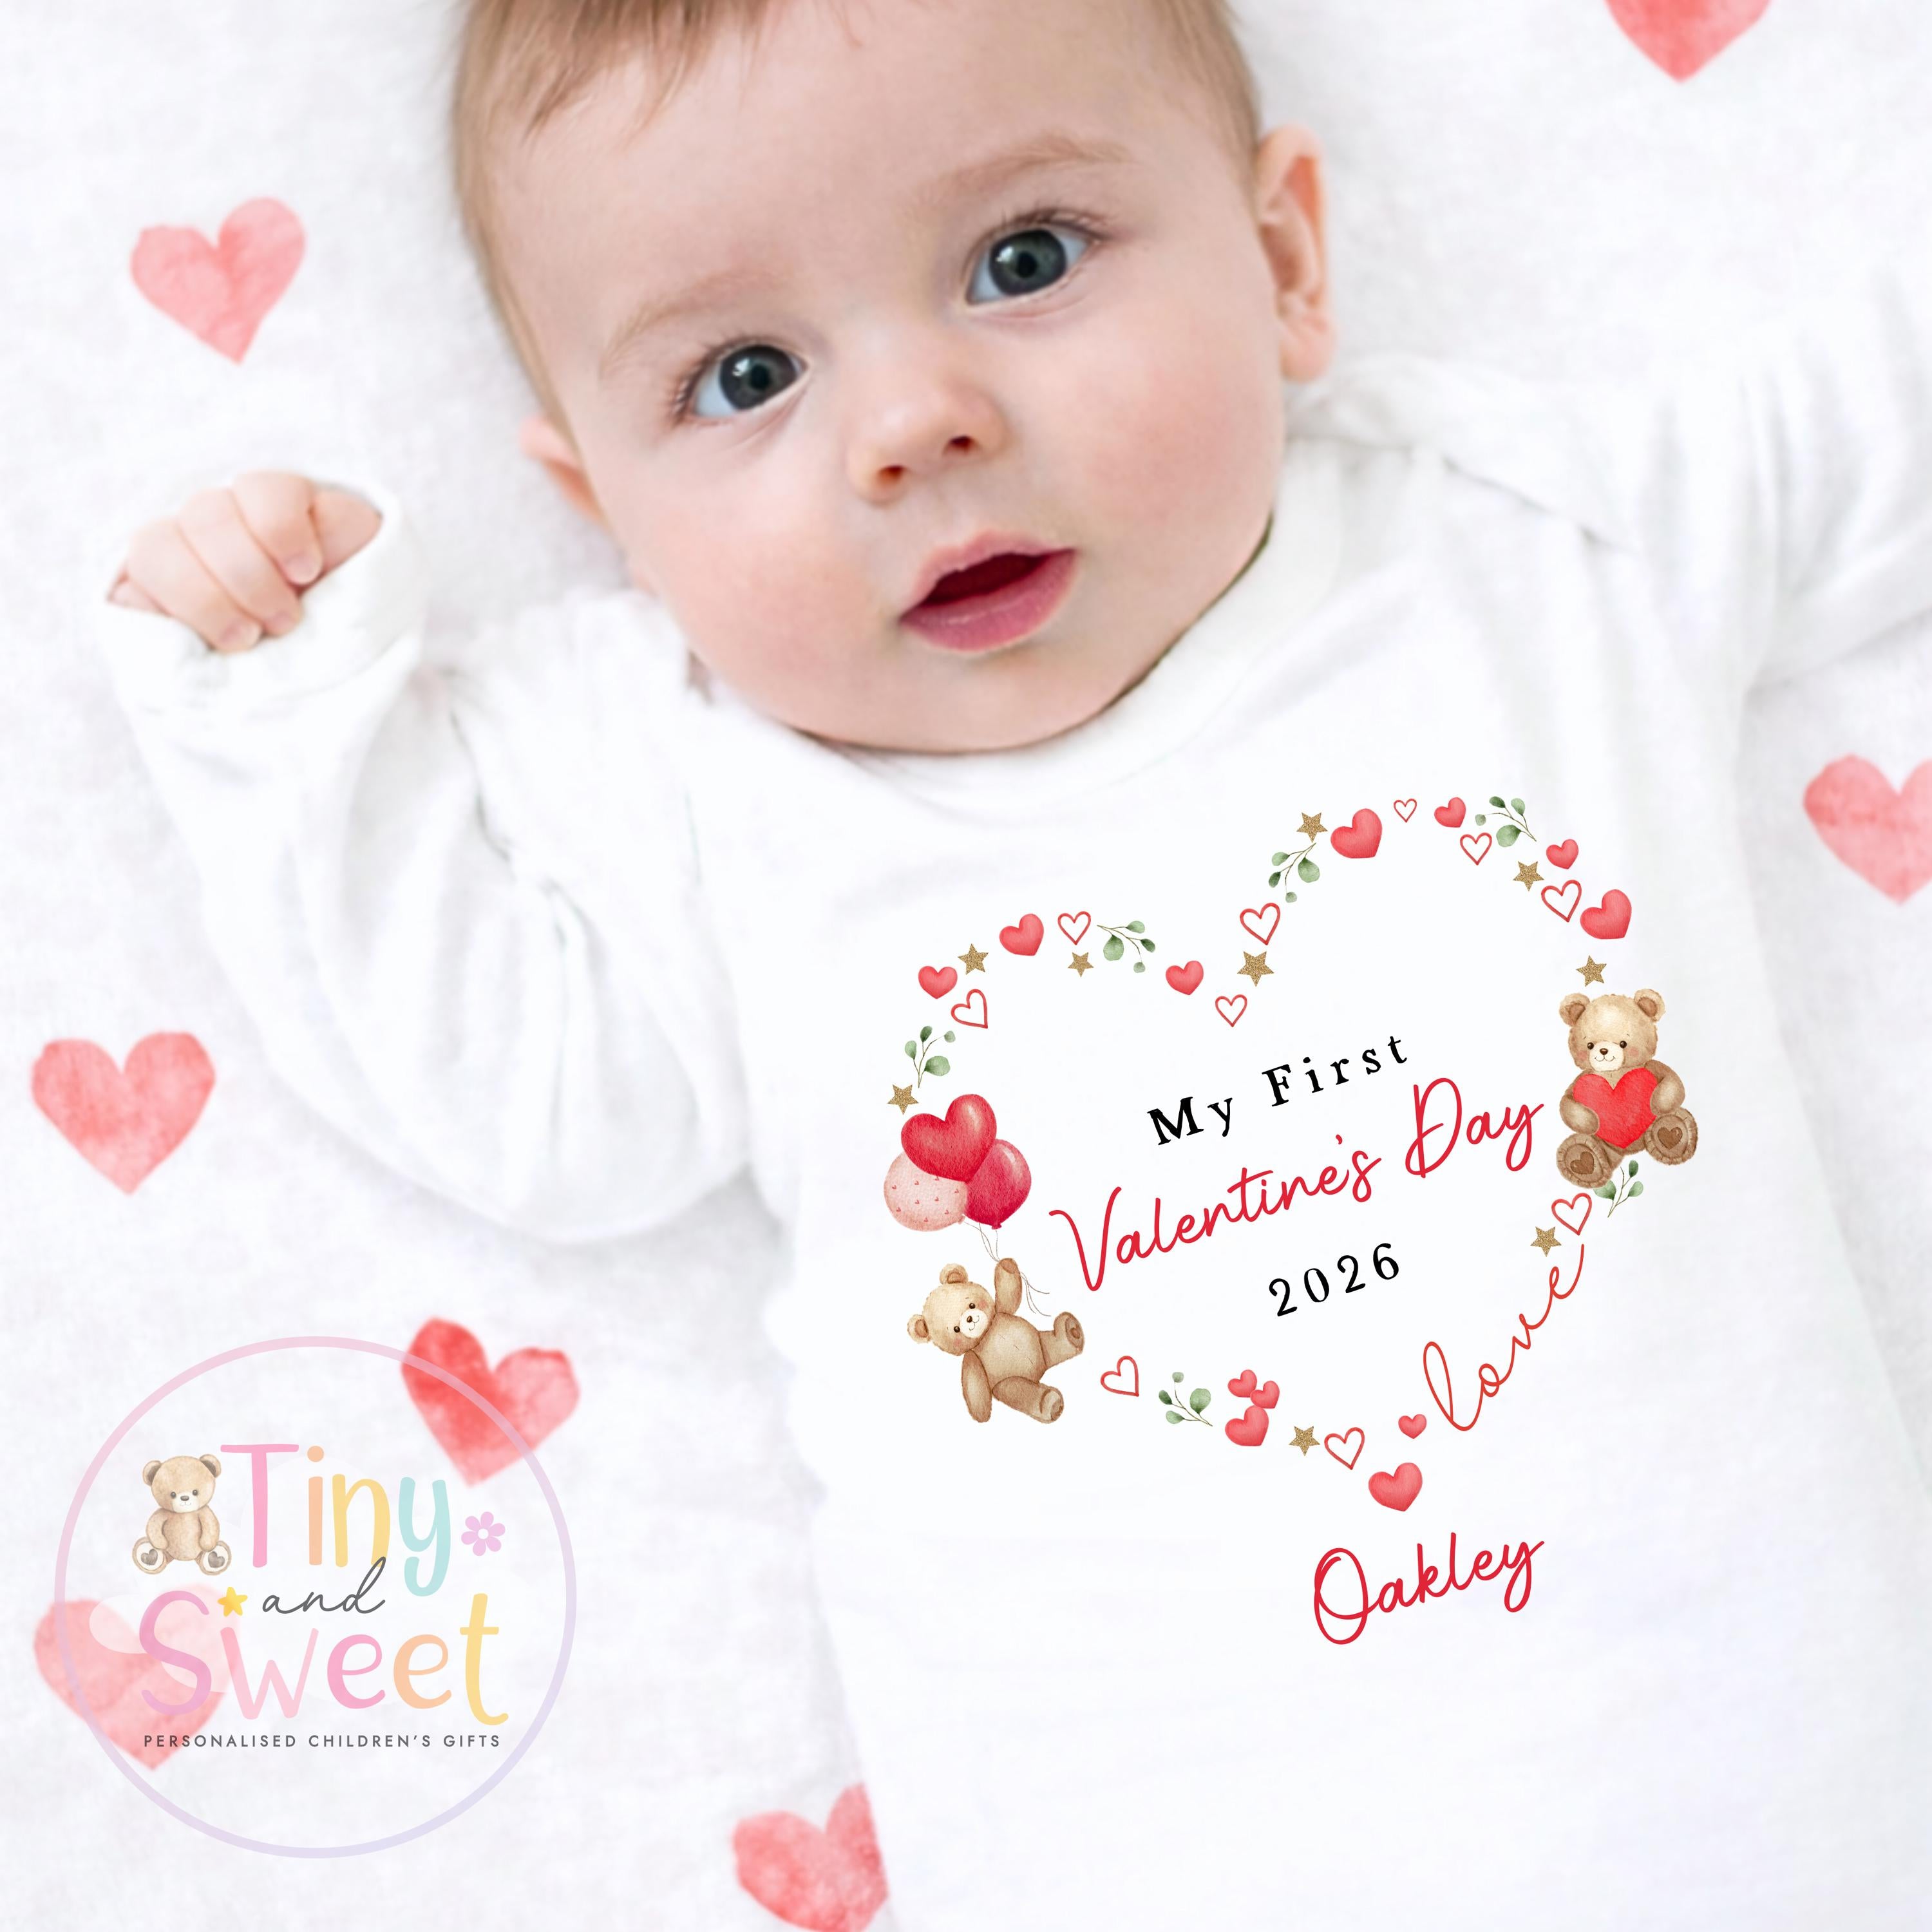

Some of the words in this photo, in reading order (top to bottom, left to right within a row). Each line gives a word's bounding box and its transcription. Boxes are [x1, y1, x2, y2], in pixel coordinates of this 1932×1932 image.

[1147, 1096, 1233, 1146] My
[1262, 1036, 1408, 1107] First
[1048, 1134, 1382, 1292] Valentine's
[1405, 1077, 1545, 1179] Day
[1269, 1242, 1400, 1317] 2026
[1423, 1244, 1585, 1432] love
[1314, 1532, 1546, 1645] Oakley
